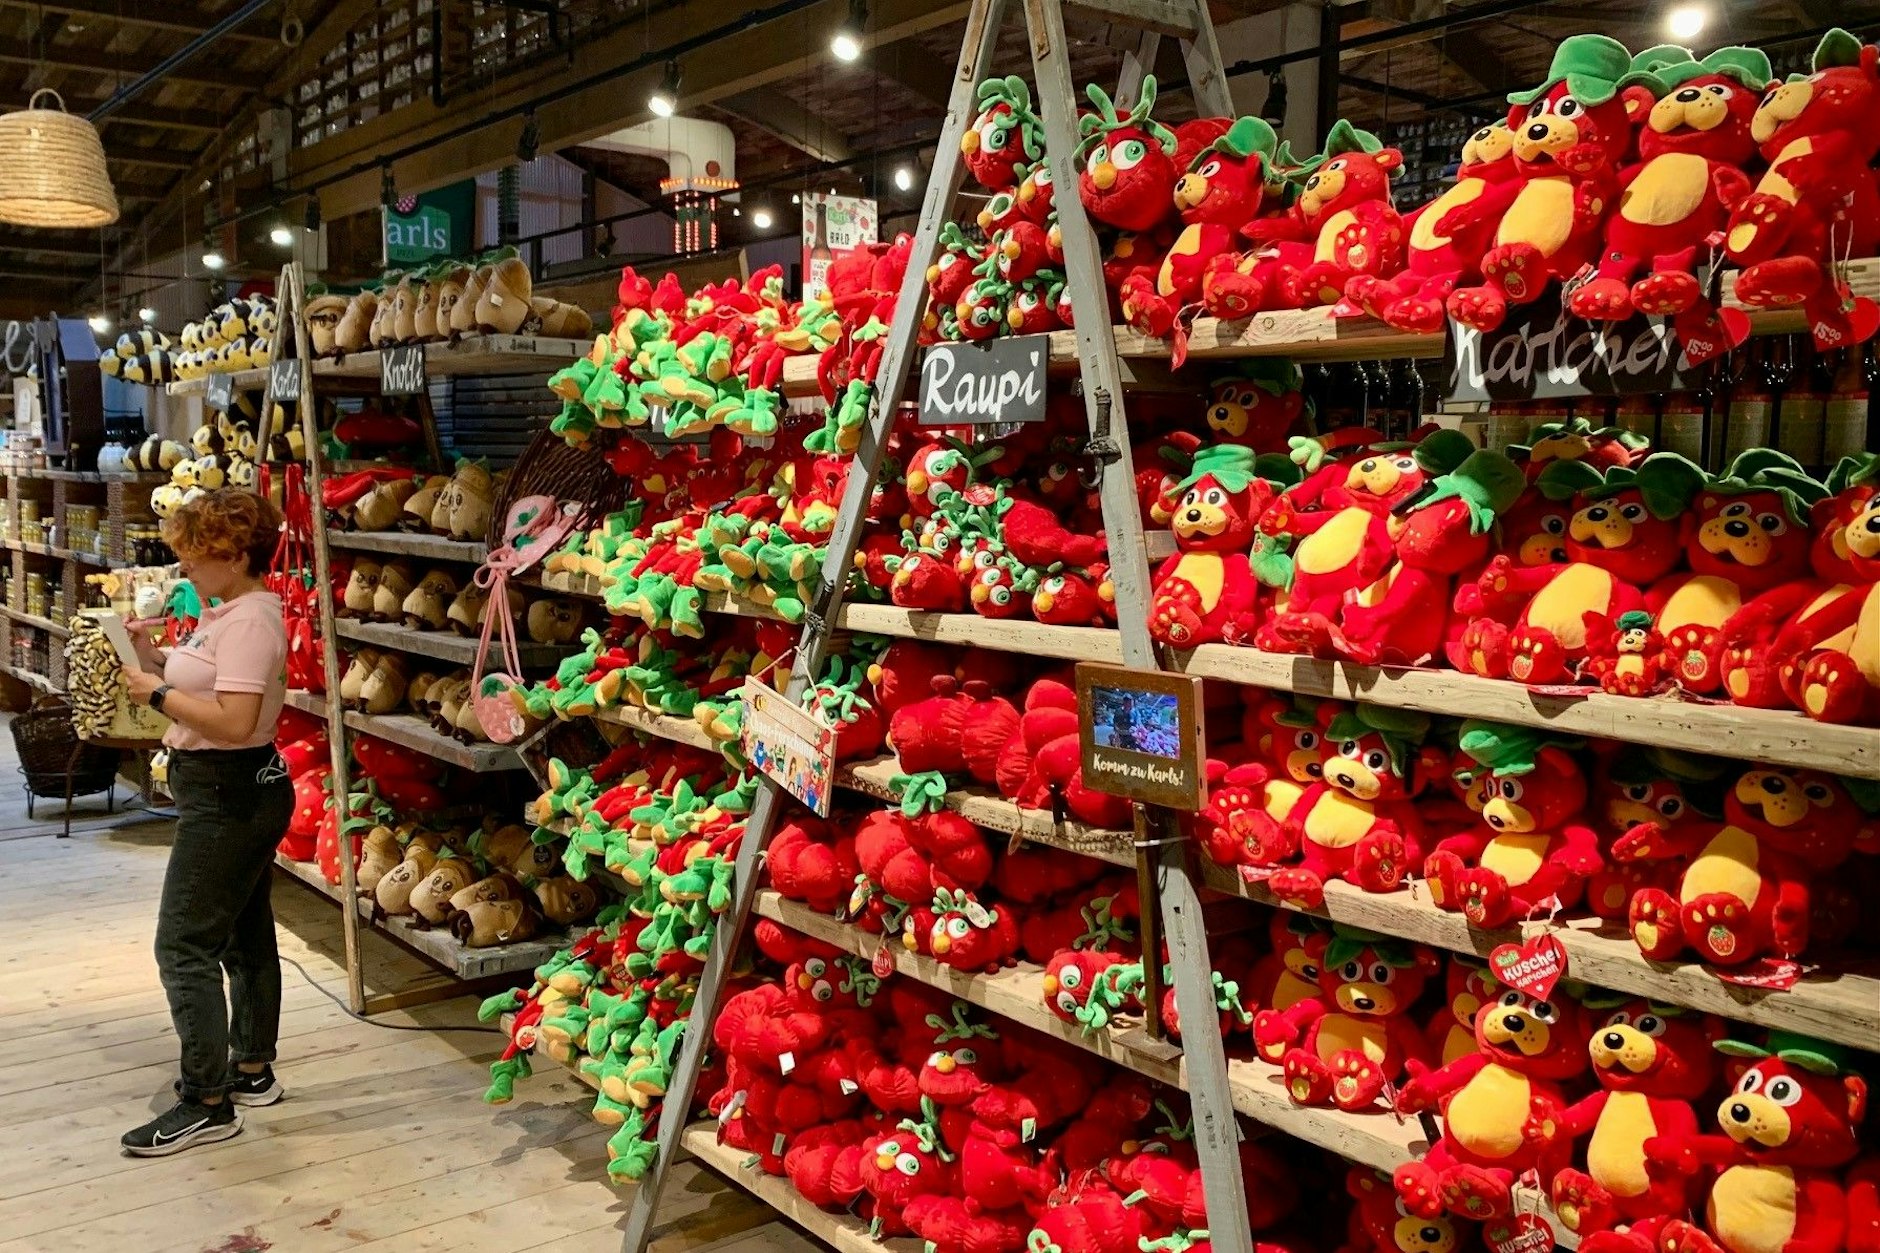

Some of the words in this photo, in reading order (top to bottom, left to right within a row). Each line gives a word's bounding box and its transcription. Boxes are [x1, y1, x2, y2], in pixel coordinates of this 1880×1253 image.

[387, 216, 447, 250] arls
[921, 346, 1041, 421] Raupi
[1093, 753, 1131, 776] Komm
[1130, 765, 1147, 780] zu
[1147, 763, 1184, 786] Karls!
